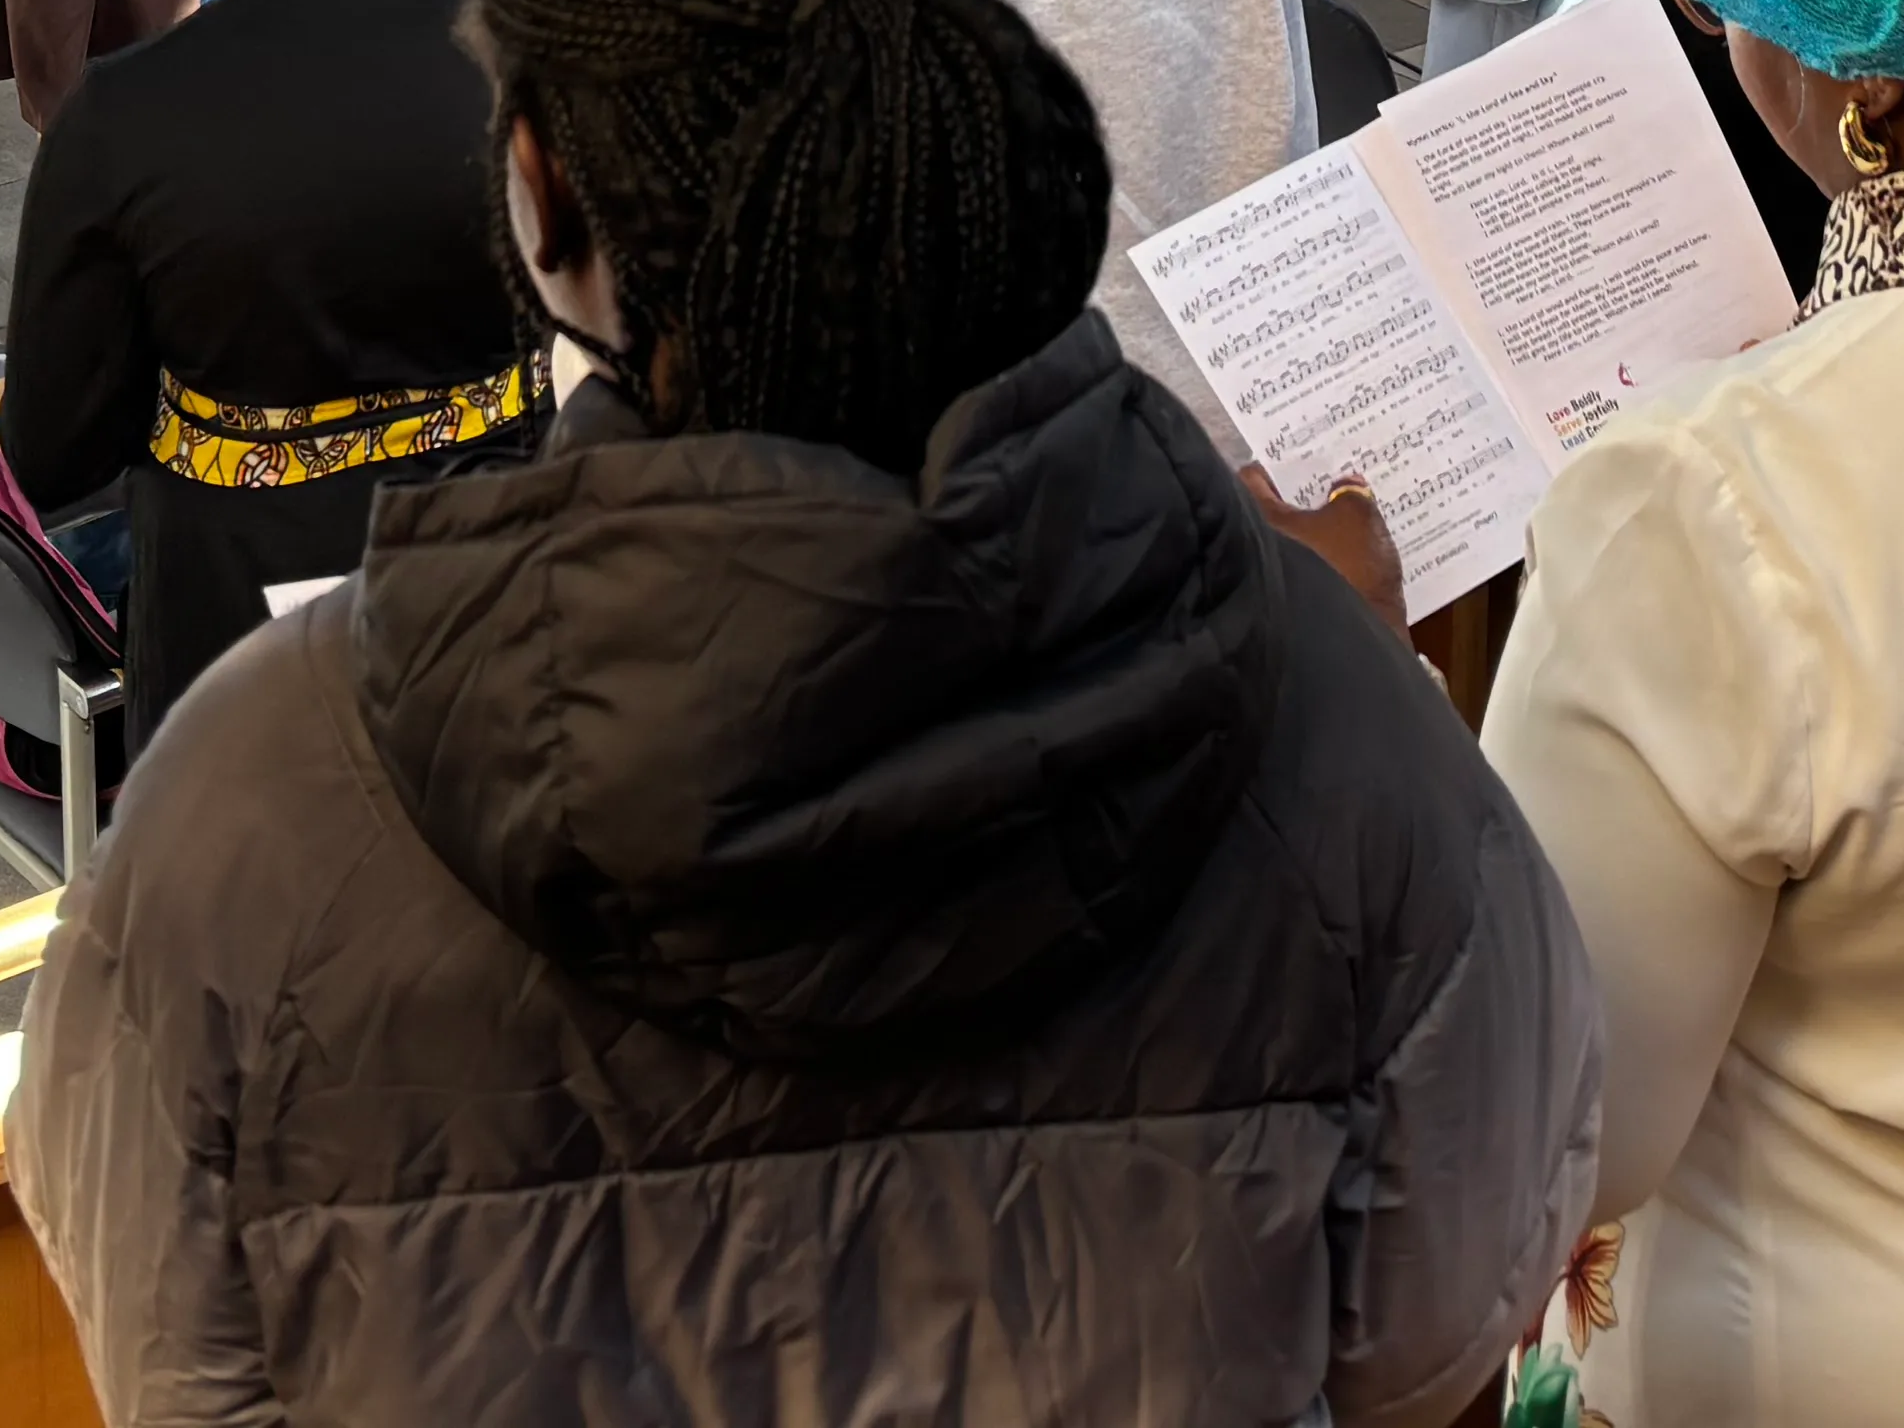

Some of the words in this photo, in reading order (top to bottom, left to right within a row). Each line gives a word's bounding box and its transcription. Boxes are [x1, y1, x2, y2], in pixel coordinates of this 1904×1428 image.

[1545, 406, 1571, 425] Love
[1569, 390, 1602, 412] Boldly
[1553, 418, 1582, 437] Serve
[1582, 399, 1619, 424] Joyfully
[1560, 430, 1586, 451] Lead
